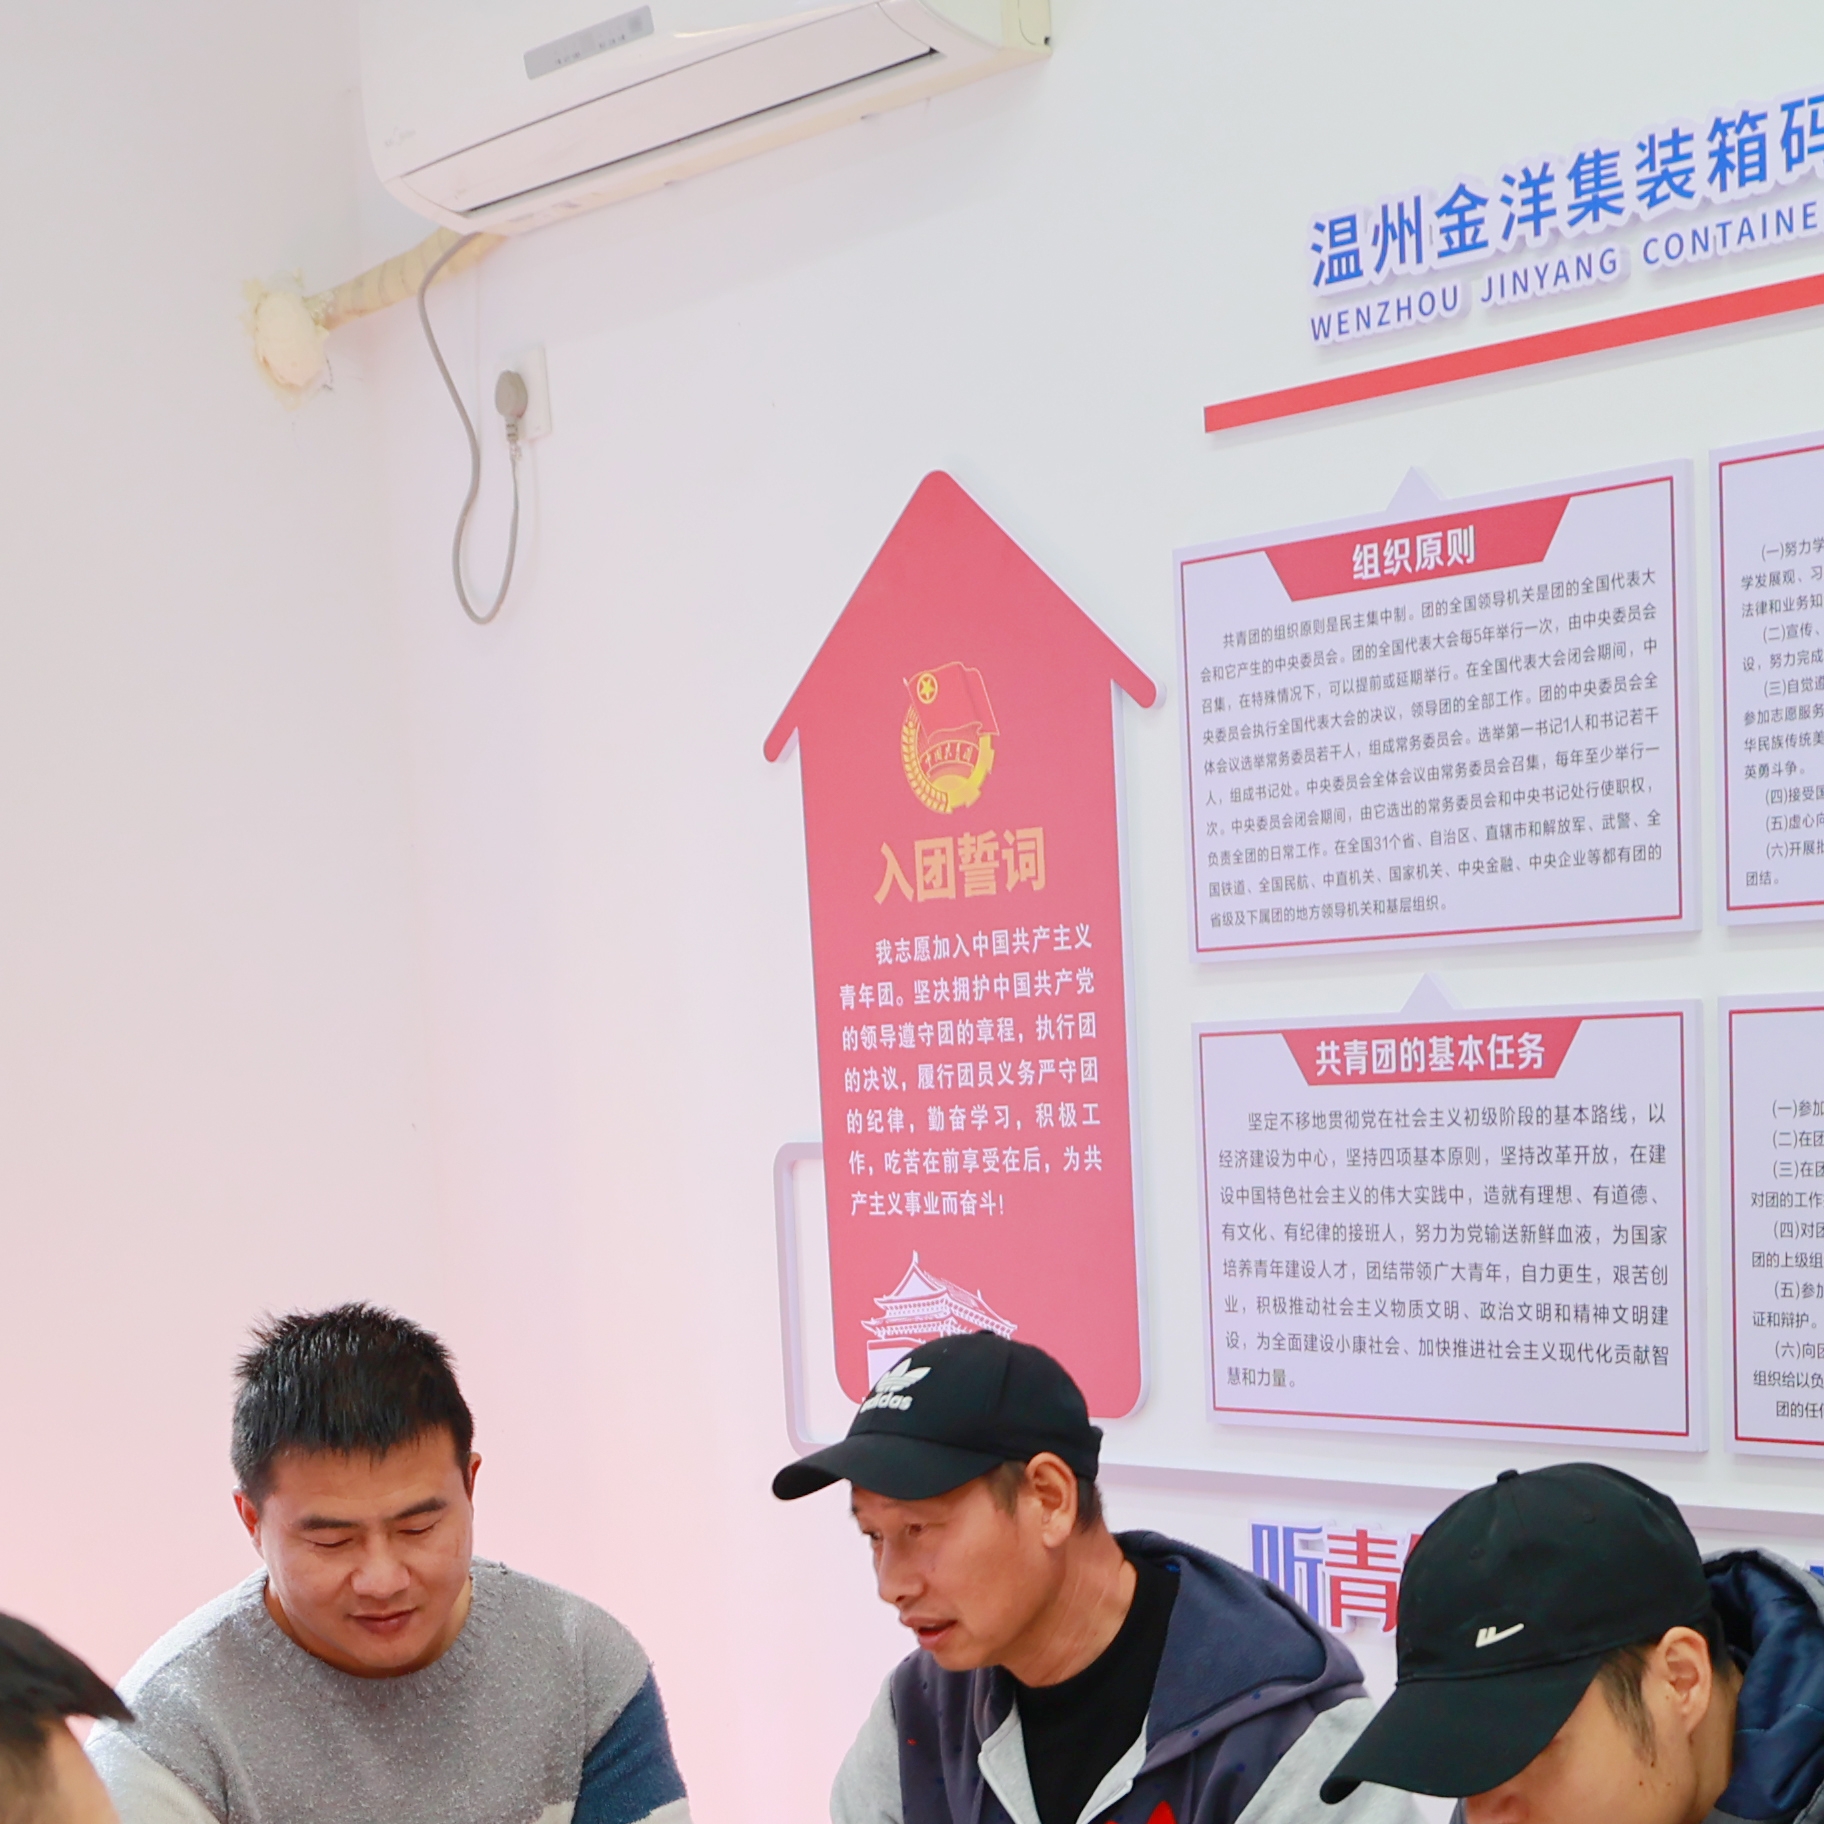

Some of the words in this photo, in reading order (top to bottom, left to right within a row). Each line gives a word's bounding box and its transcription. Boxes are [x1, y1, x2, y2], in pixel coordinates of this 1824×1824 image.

[1311, 285, 1459, 342] WENZHOU
[1481, 247, 1618, 303] JINYANG
[1352, 523, 1475, 580] 组织原则
[874, 827, 1047, 905] 入团誓词
[1315, 1031, 1545, 1077] 共青团的基本任务
[859, 1392, 914, 1414] addas
